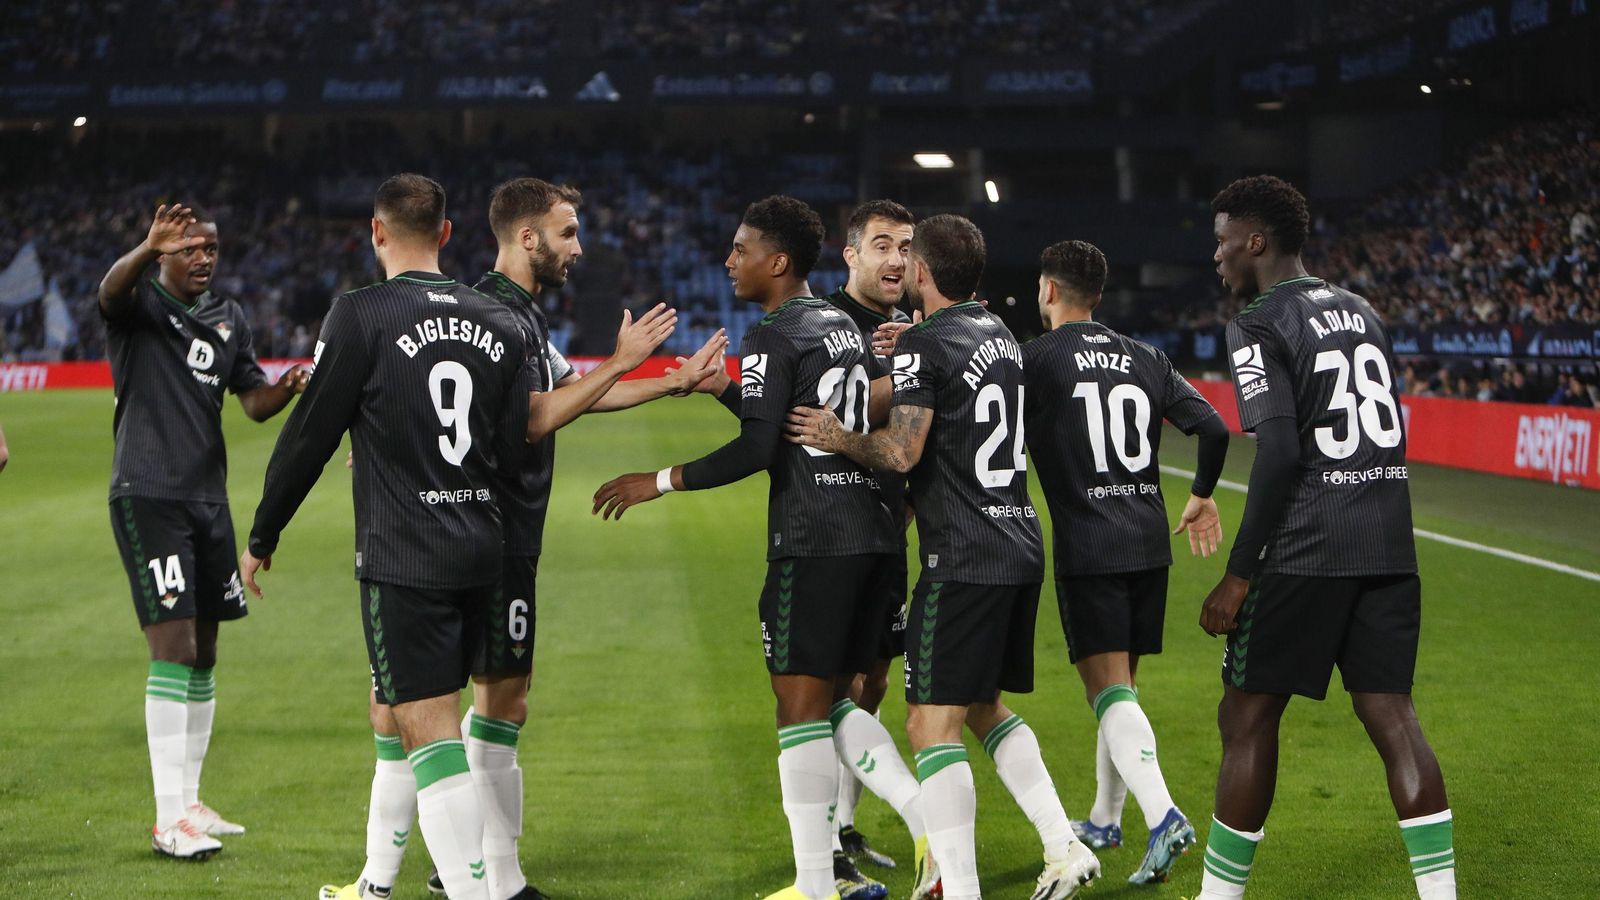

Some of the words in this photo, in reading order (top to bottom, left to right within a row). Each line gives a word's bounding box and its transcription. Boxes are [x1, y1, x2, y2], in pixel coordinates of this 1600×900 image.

[396, 317, 505, 363] B.IGLESIAS
[962, 339, 998, 391] AITOR
[1074, 350, 1132, 374] AYOZE
[742, 385, 763, 394] EALE
[1242, 378, 1268, 395] REALE
[1314, 342, 1402, 460] 38
[428, 360, 473, 467] 9
[1072, 382, 1152, 473] 10
[1322, 467, 1382, 485] FOREVER
[148, 554, 185, 596] 14
[508, 599, 528, 641] 6
